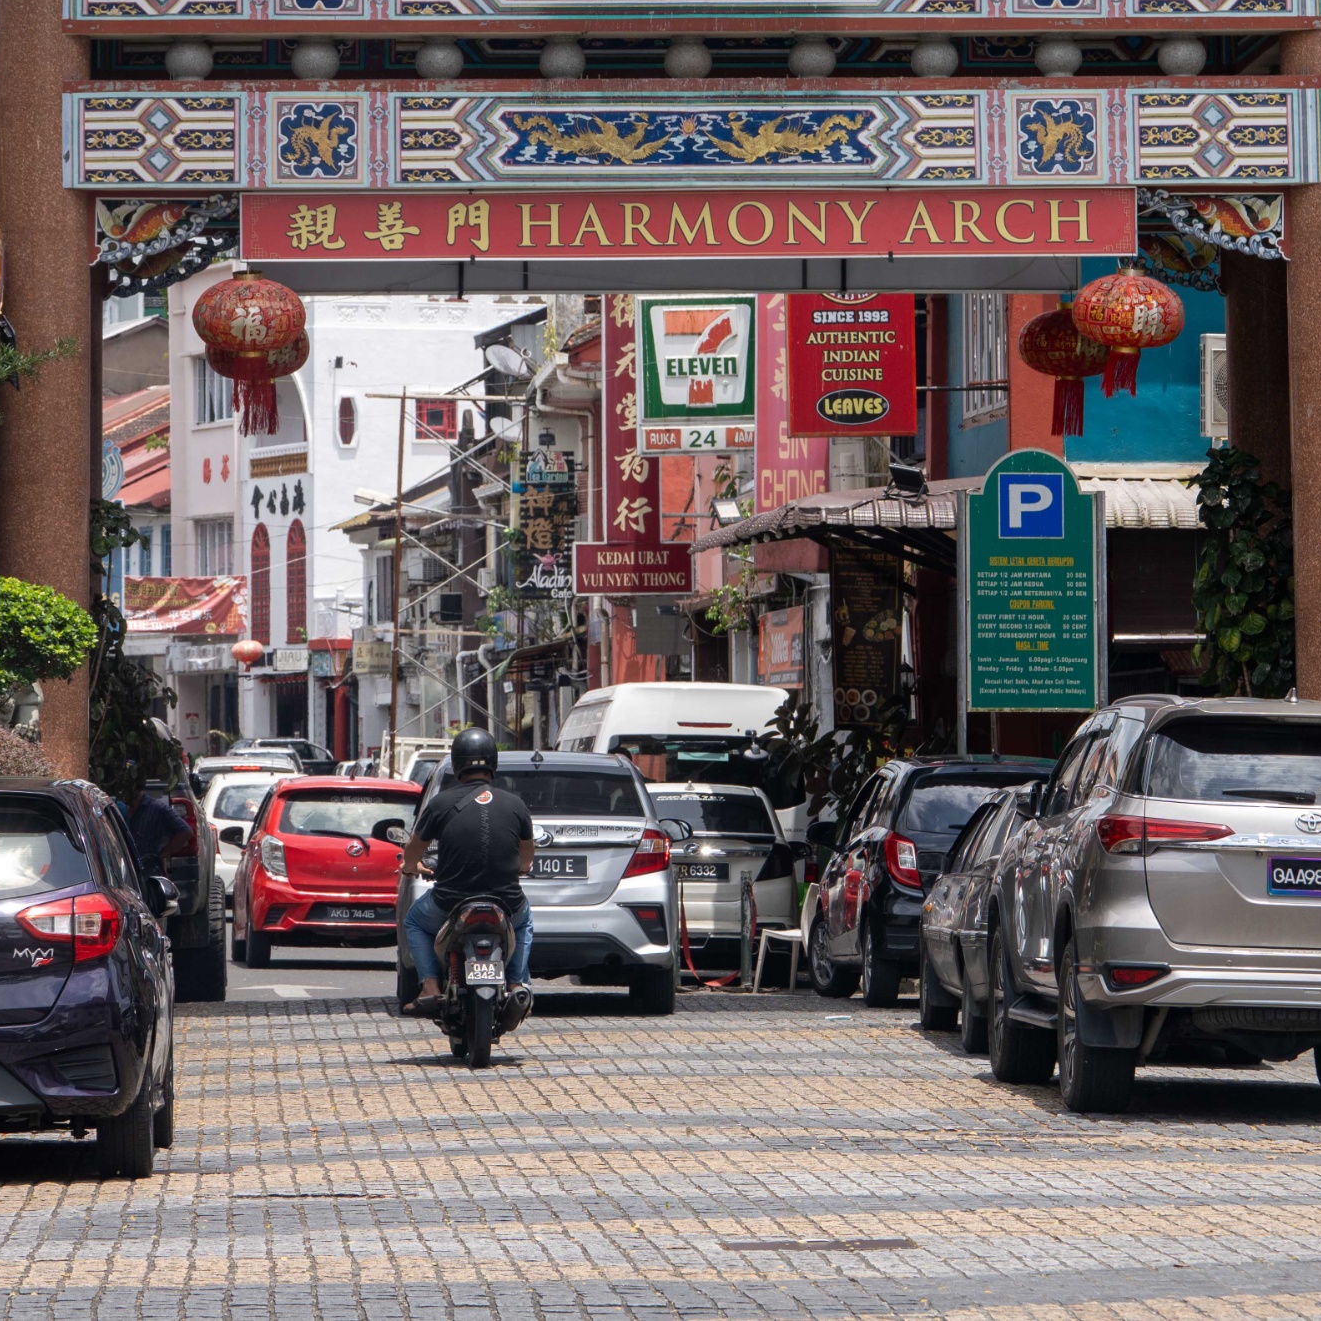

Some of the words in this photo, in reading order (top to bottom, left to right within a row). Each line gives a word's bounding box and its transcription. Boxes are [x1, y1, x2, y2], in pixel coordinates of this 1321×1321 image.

[286, 199, 491, 252] 親善門
[516, 199, 878, 248] HARMONY
[906, 199, 1094, 244] ARCH
[230, 306, 267, 342] 福
[813, 310, 854, 324] SINCE
[858, 310, 889, 324] 1992
[806, 331, 896, 345] AUTHENTIC
[823, 350, 881, 363] INDIAN
[821, 368, 884, 381] CUISINE
[824, 397, 884, 416] LEAVES
[689, 430, 717, 448] 24
[761, 469, 826, 508] CHONG
[1008, 484, 1053, 528] P
[597, 550, 635, 565] KEDAI
[638, 550, 670, 565] UBAT
[516, 563, 573, 588] Aladin
[581, 573, 603, 587] VUI
[606, 573, 639, 587] NYEN
[642, 572, 685, 587] THONG
[1010, 599, 1030, 609] COUPON
[1015, 641, 1030, 650] MASA
[1037, 641, 1049, 650] TIME
[537, 859, 560, 873] 140
[565, 859, 574, 873] E
[690, 865, 716, 876] 6332
[353, 909, 375, 919] 7446
[467, 971, 503, 979] 4342J
[473, 964, 495, 972] QAA
